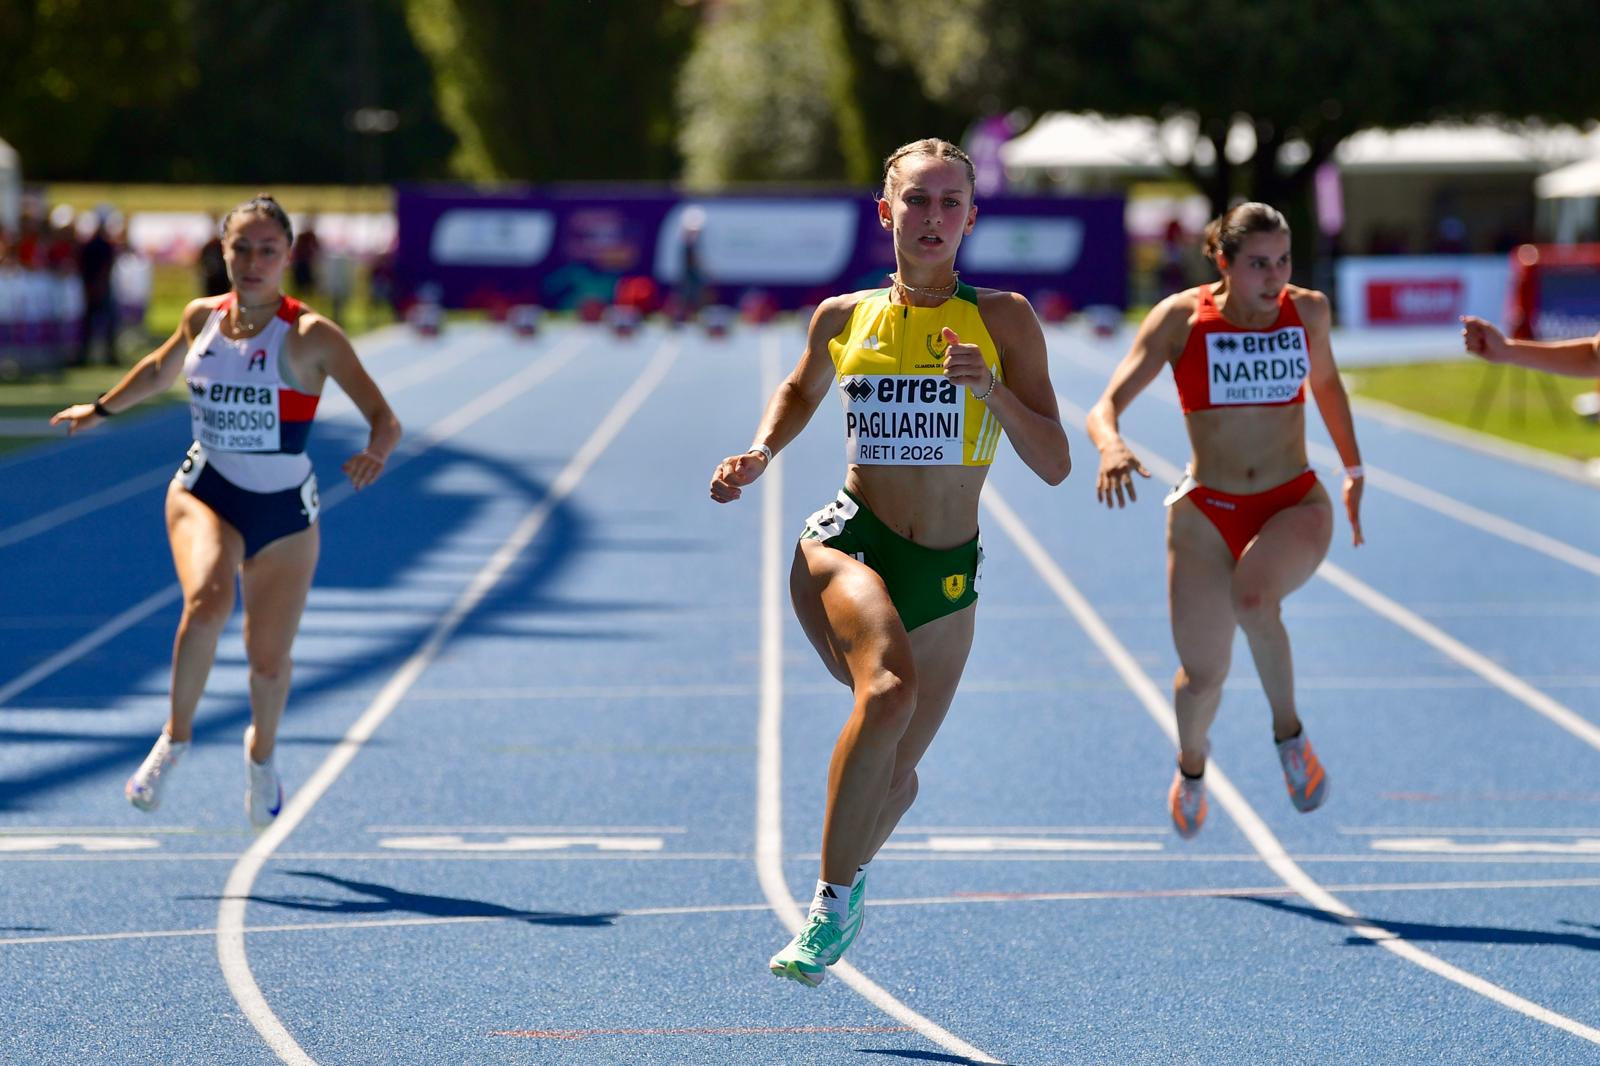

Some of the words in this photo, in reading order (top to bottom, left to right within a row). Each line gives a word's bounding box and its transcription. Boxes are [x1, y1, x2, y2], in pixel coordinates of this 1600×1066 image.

[1243, 332, 1302, 353] errea
[1213, 358, 1307, 383] NARDIS
[210, 383, 272, 404] errea
[877, 377, 957, 404] errea
[1226, 387, 1264, 399] RIETI
[846, 411, 959, 438] PAGLIARINI
[228, 434, 265, 447] 2026
[860, 444, 896, 460] RIETI
[900, 445, 944, 460] 2026
